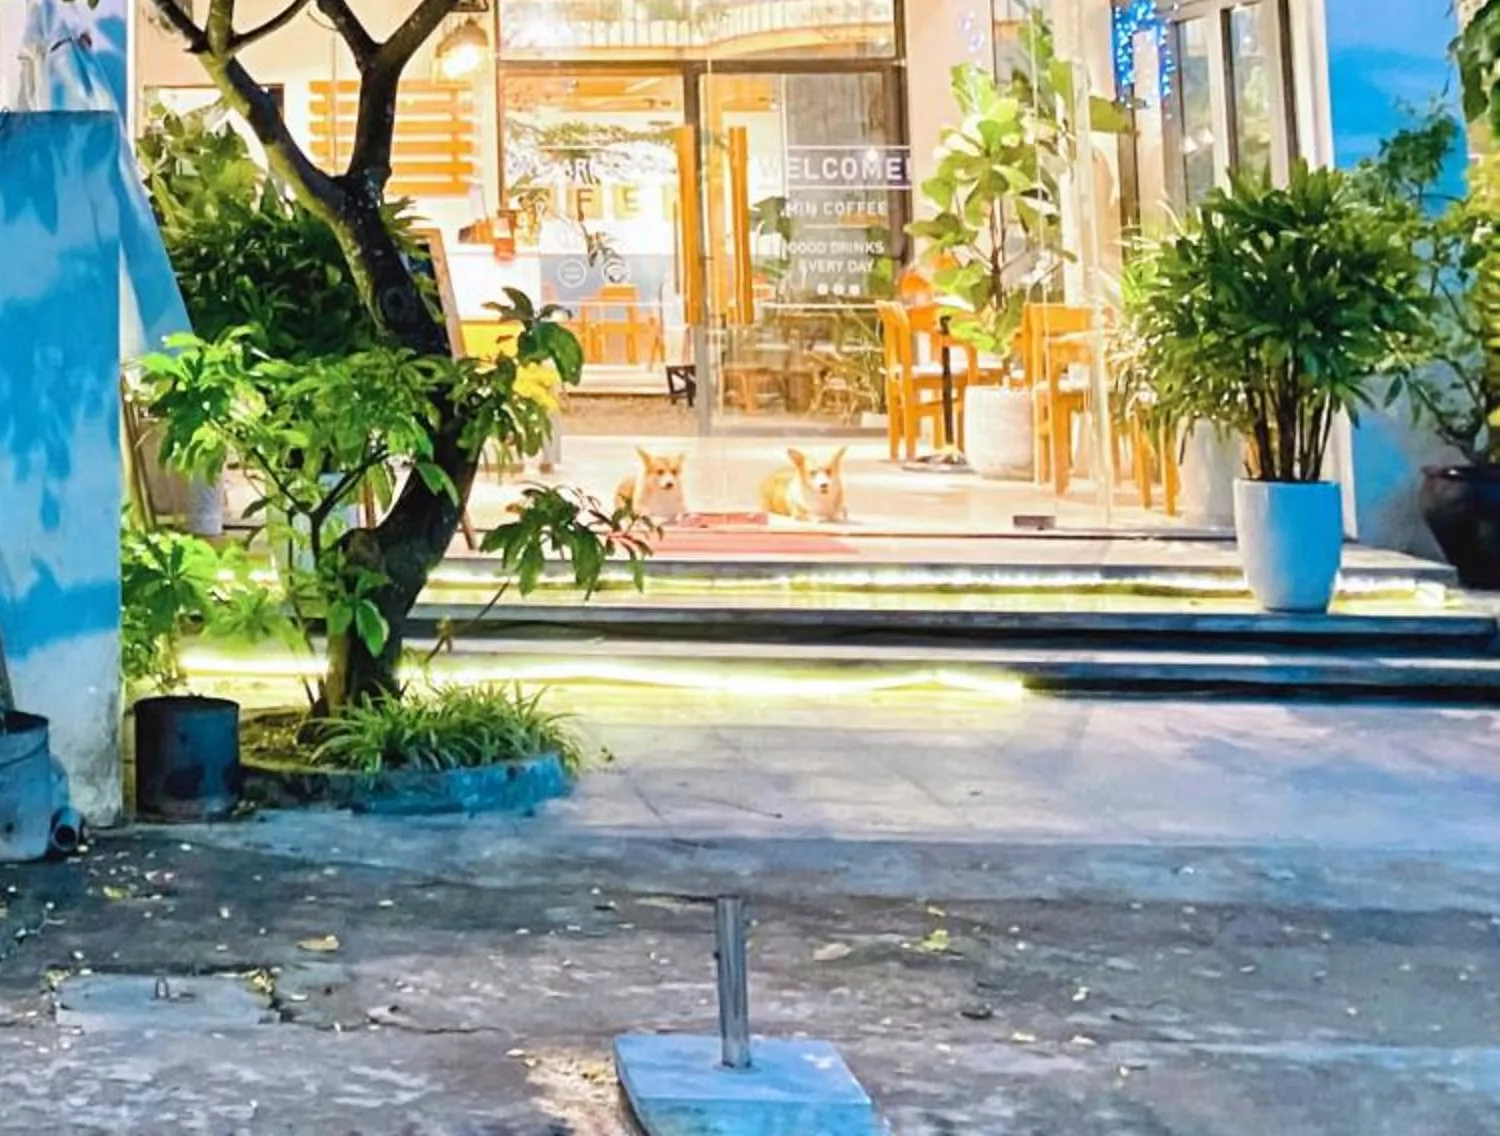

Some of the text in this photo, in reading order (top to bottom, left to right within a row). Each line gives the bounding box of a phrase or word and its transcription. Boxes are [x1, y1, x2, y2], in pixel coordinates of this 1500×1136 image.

[823, 201, 887, 215] COFFEE
[830, 240, 886, 254] DRINKS
[848, 259, 875, 273] DAY
